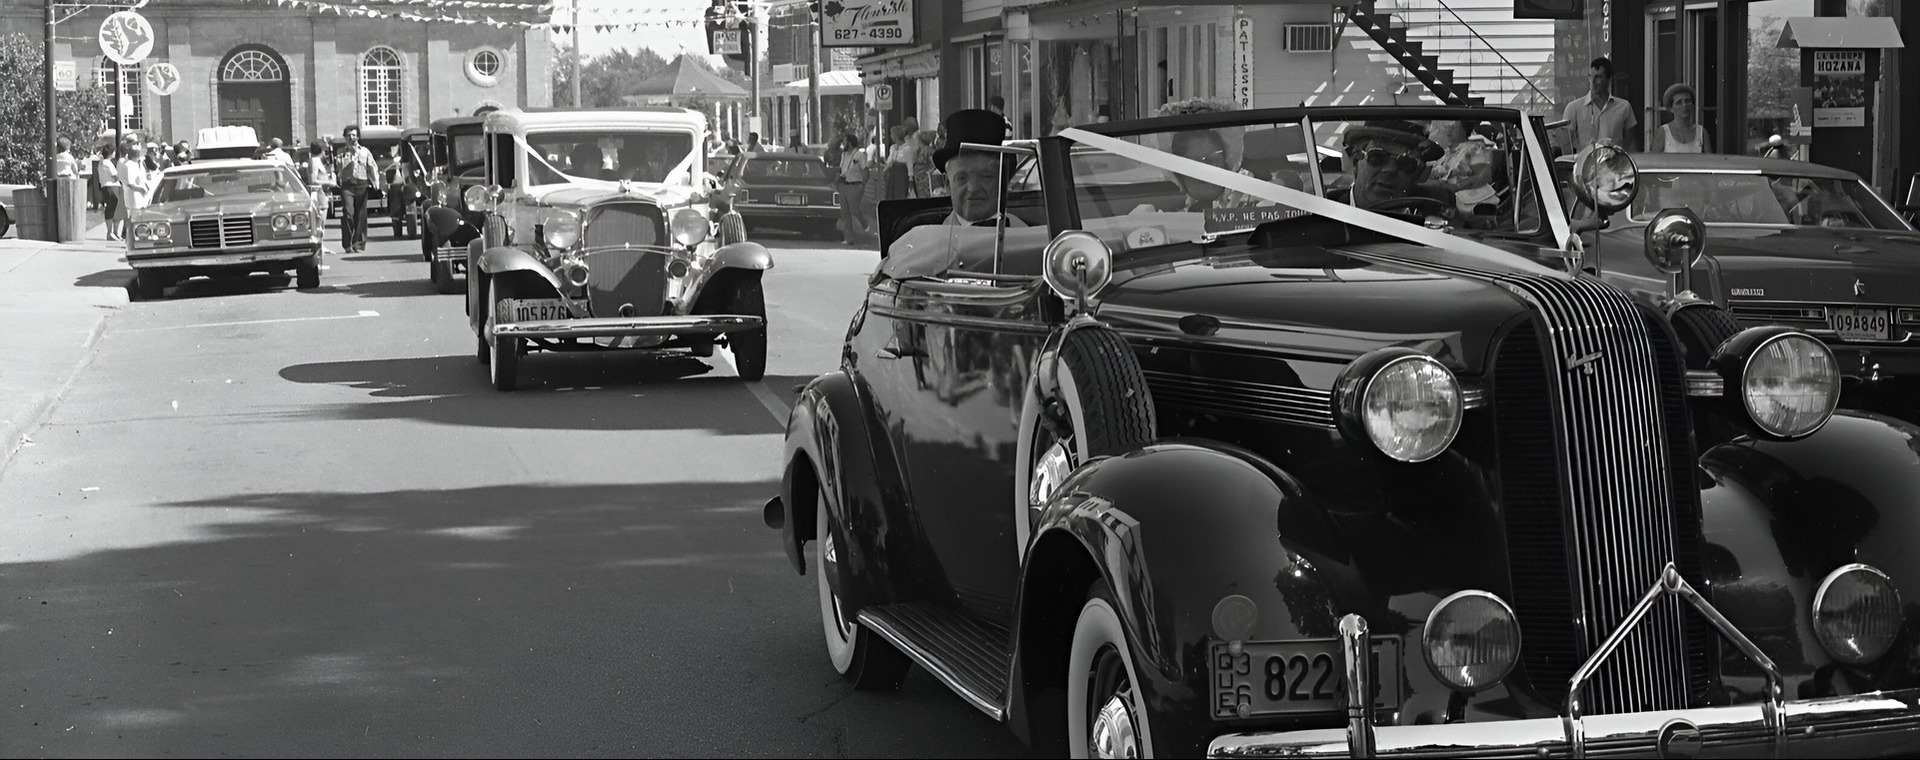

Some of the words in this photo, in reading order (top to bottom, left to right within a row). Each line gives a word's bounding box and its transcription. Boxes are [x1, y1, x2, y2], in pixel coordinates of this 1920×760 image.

[834, 27, 903, 40] 627-4390
[1817, 61, 1862, 72] HOZANA
[1829, 314, 1886, 333] 109A849
